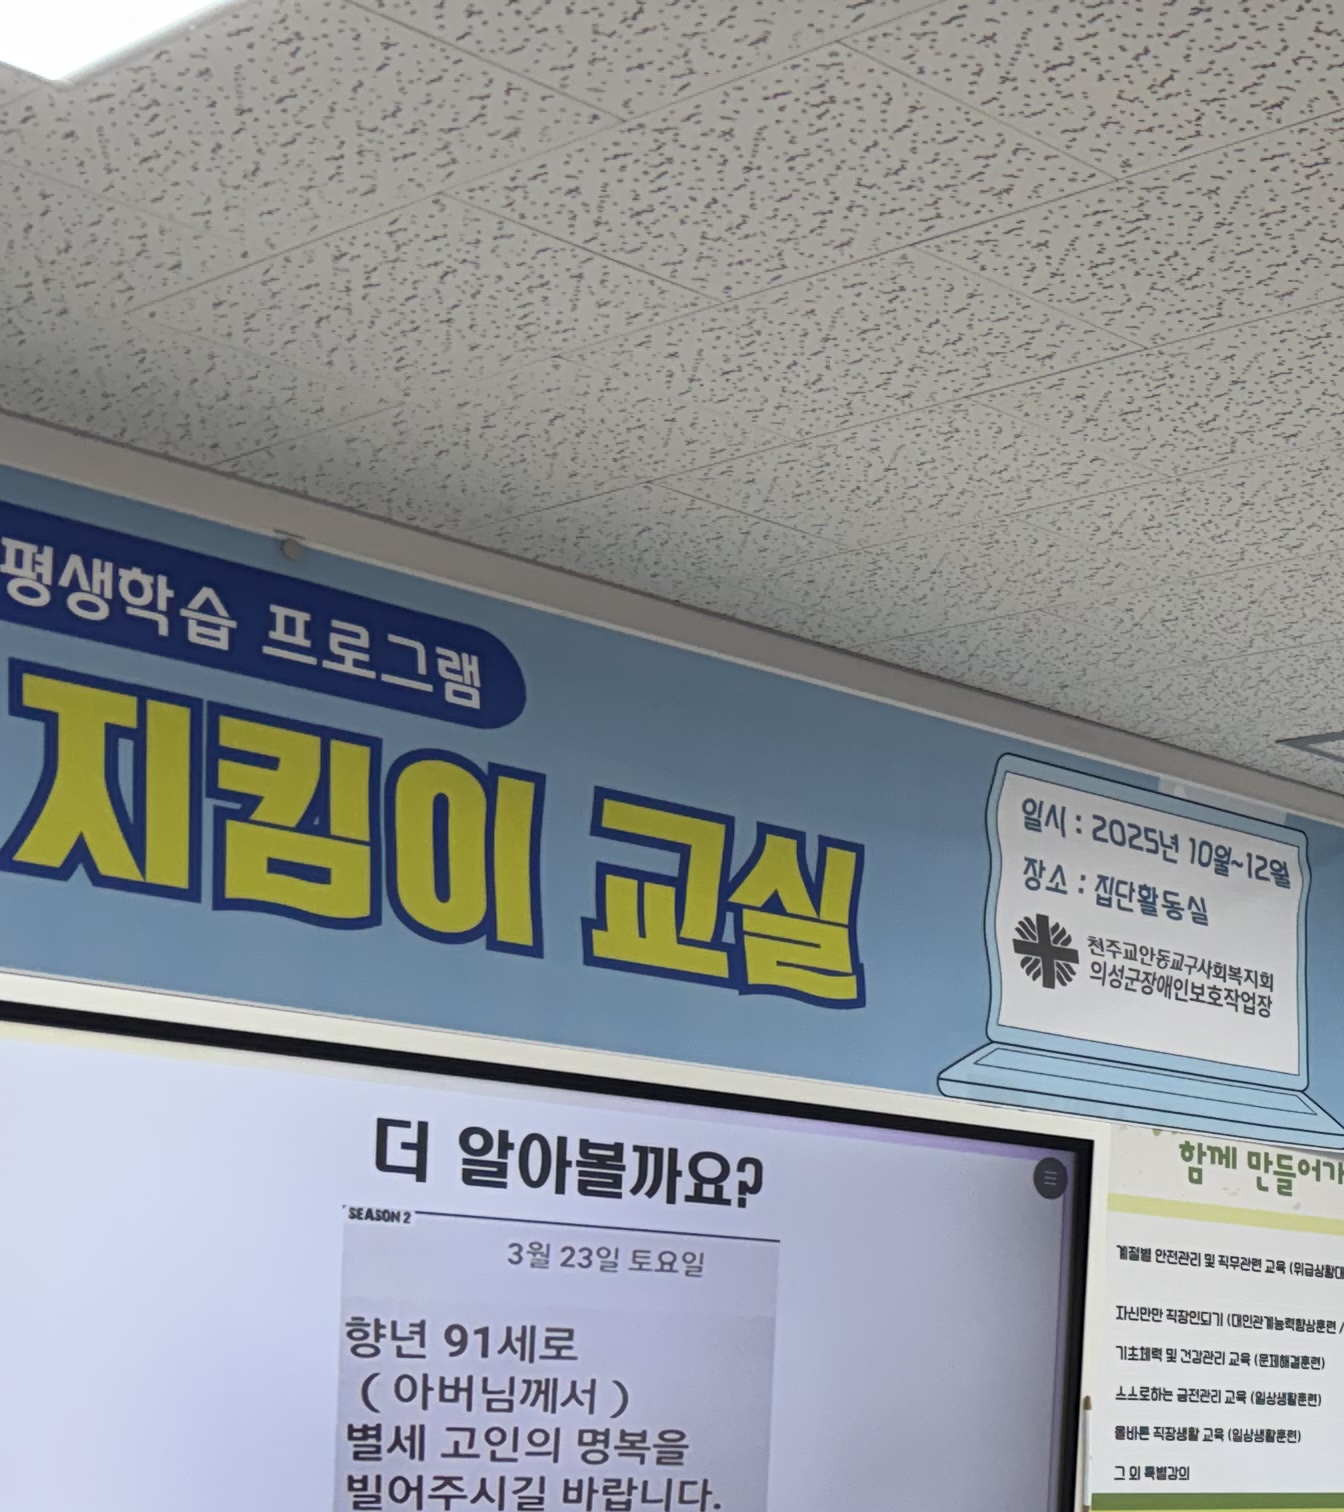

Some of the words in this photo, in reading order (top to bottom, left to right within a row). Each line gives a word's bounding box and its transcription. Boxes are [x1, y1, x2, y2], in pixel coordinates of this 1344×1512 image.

[1, 536, 236, 651] 평생학습
[263, 603, 482, 710] 프로그램
[6, 662, 545, 957] 지킴이
[584, 787, 866, 1010] 교실
[1021, 798, 1066, 838] 일시
[1092, 814, 1180, 864] 2025년
[1189, 837, 1291, 889] 10월~12월
[1023, 856, 1068, 895] 장소
[1094, 874, 1209, 926] 집단활동실
[1087, 935, 1274, 992] 천주교안동교구사회복지회
[1089, 961, 1273, 1018] 의성군장애인보호작업장
[375, 1117, 429, 1183] 더
[458, 1125, 764, 1208] 알아볼까요?
[1178, 1140, 1238, 1185] 함께
[347, 1206, 401, 1223] SEASON
[402, 1211, 411, 1224] 2
[507, 1241, 551, 1270] 3월
[559, 1245, 620, 1273] 23일
[628, 1249, 705, 1278] 토요일
[1155, 1248, 1201, 1267] 안전관리
[1218, 1254, 1262, 1273] 직무관련
[1264, 1259, 1286, 1275] 교육
[1115, 1305, 1163, 1322] 자신만만
[1166, 1308, 1223, 1327] 직장인되기
[345, 1316, 427, 1359] 향년
[443, 1323, 578, 1364] 91세로
[1115, 1345, 1162, 1362] 기초체력
[1180, 1349, 1225, 1365] 건강관리
[1228, 1352, 1251, 1366] 교육
[393, 1373, 597, 1415] 아버님께서
[1115, 1385, 1173, 1402] 스스로하는
[1176, 1388, 1221, 1404] 금전관리
[1224, 1390, 1247, 1405] 교육
[346, 1423, 426, 1462] 별세
[440, 1425, 561, 1464] 고인의
[577, 1427, 689, 1466] 명복을
[1153, 1426, 1200, 1442] 직장생활
[1202, 1428, 1224, 1443] 교육
[346, 1474, 546, 1512] 빌어주시길
[562, 1476, 722, 1512] 바랍니다.
[1114, 1466, 1126, 1480] 그
[1129, 1466, 1141, 1480] 외
[1144, 1465, 1190, 1481] 특별강의
